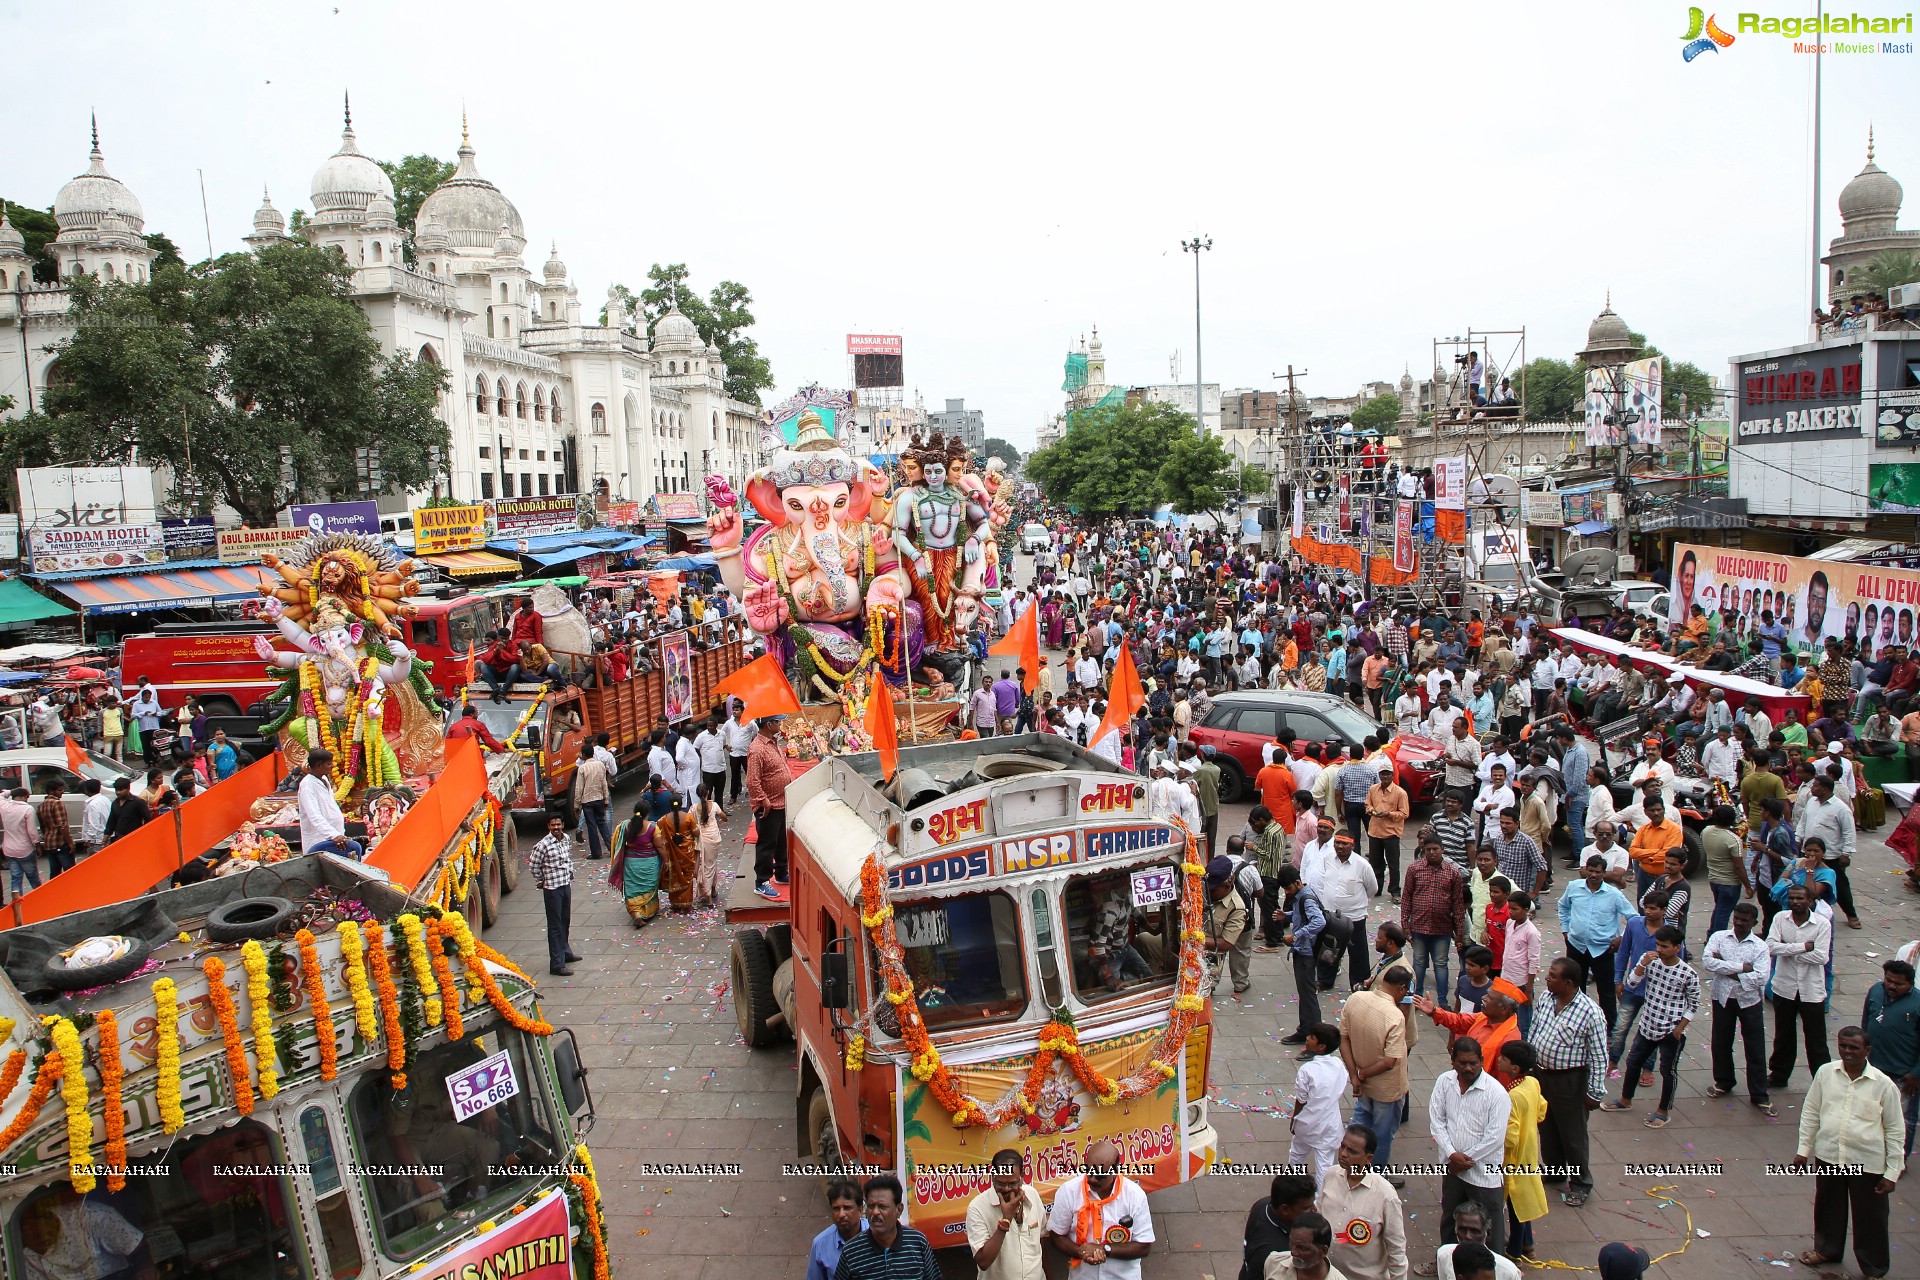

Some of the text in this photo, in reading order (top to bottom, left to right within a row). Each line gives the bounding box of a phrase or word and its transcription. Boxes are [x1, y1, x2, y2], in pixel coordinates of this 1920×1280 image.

[851, 337, 899, 346] BHASKAR ARTS
[1746, 364, 1861, 406] NIMRAH
[1739, 404, 1861, 437] CAFE & BAKERY
[497, 499, 575, 515] MUQADDAR HOTEL
[327, 514, 365, 526] PhonePe
[420, 508, 479, 527] MUNNU
[45, 529, 104, 544] SADDAM
[107, 527, 150, 540] HOTEL
[221, 534, 243, 545] ABUL
[244, 531, 279, 544] BARKAAT
[430, 525, 471, 538] PAN SHOP
[50, 538, 148, 551] FAMILY SECTION ALSO AVAILABLE
[1871, 550, 1889, 558] LASSI
[1716, 555, 1788, 584] WELCOME TO
[1856, 574, 1881, 600] ALL
[101, 605, 122, 613] SADDAM
[122, 603, 139, 611] HOTEL
[156, 599, 177, 608] SECTION
[1079, 782, 1135, 813] लाभ
[927, 797, 989, 847] शुभ
[1003, 833, 1073, 873] NSR
[1087, 827, 1172, 862] CARRIER
[889, 849, 990, 889] GOODS
